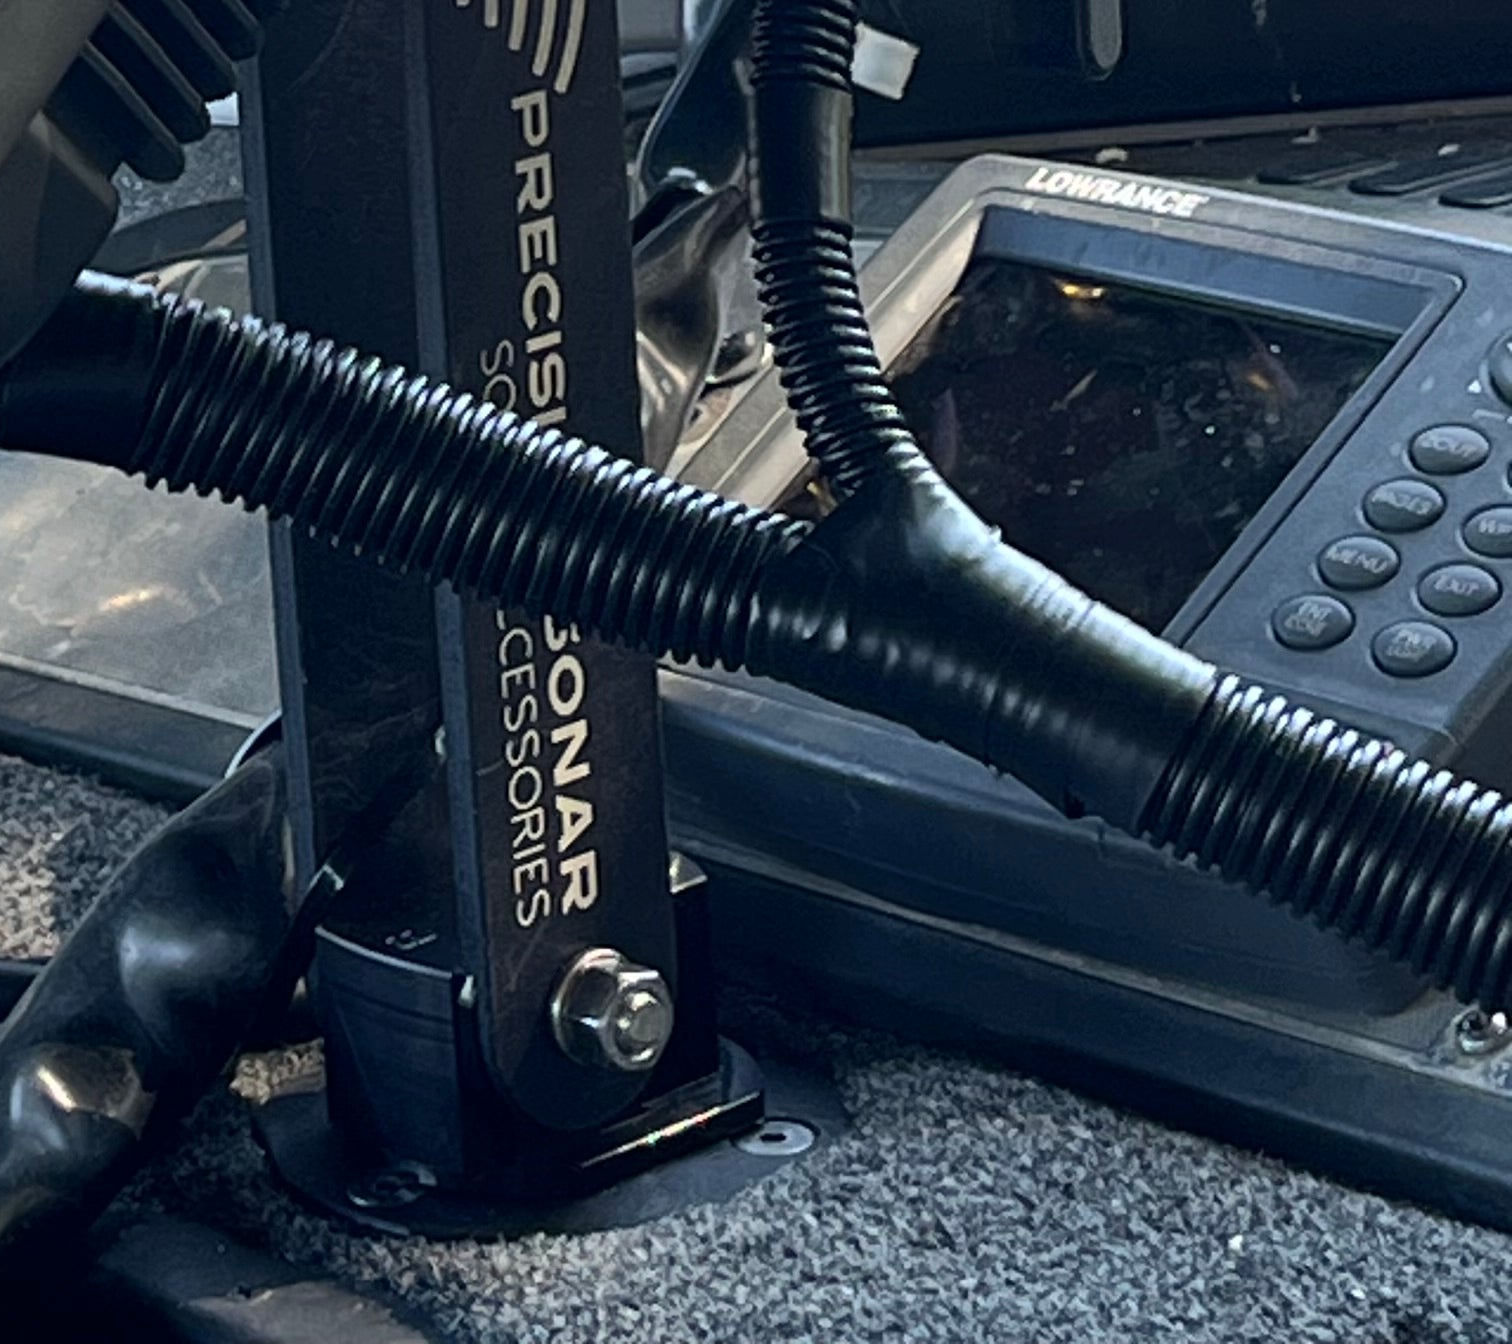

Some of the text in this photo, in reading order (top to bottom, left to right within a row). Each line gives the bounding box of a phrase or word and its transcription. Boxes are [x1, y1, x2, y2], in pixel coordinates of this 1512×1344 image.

[511, 88, 567, 427] PRECISI
[1025, 166, 1208, 218] LOWRANCE
[497, 609, 551, 928] CESSORIES
